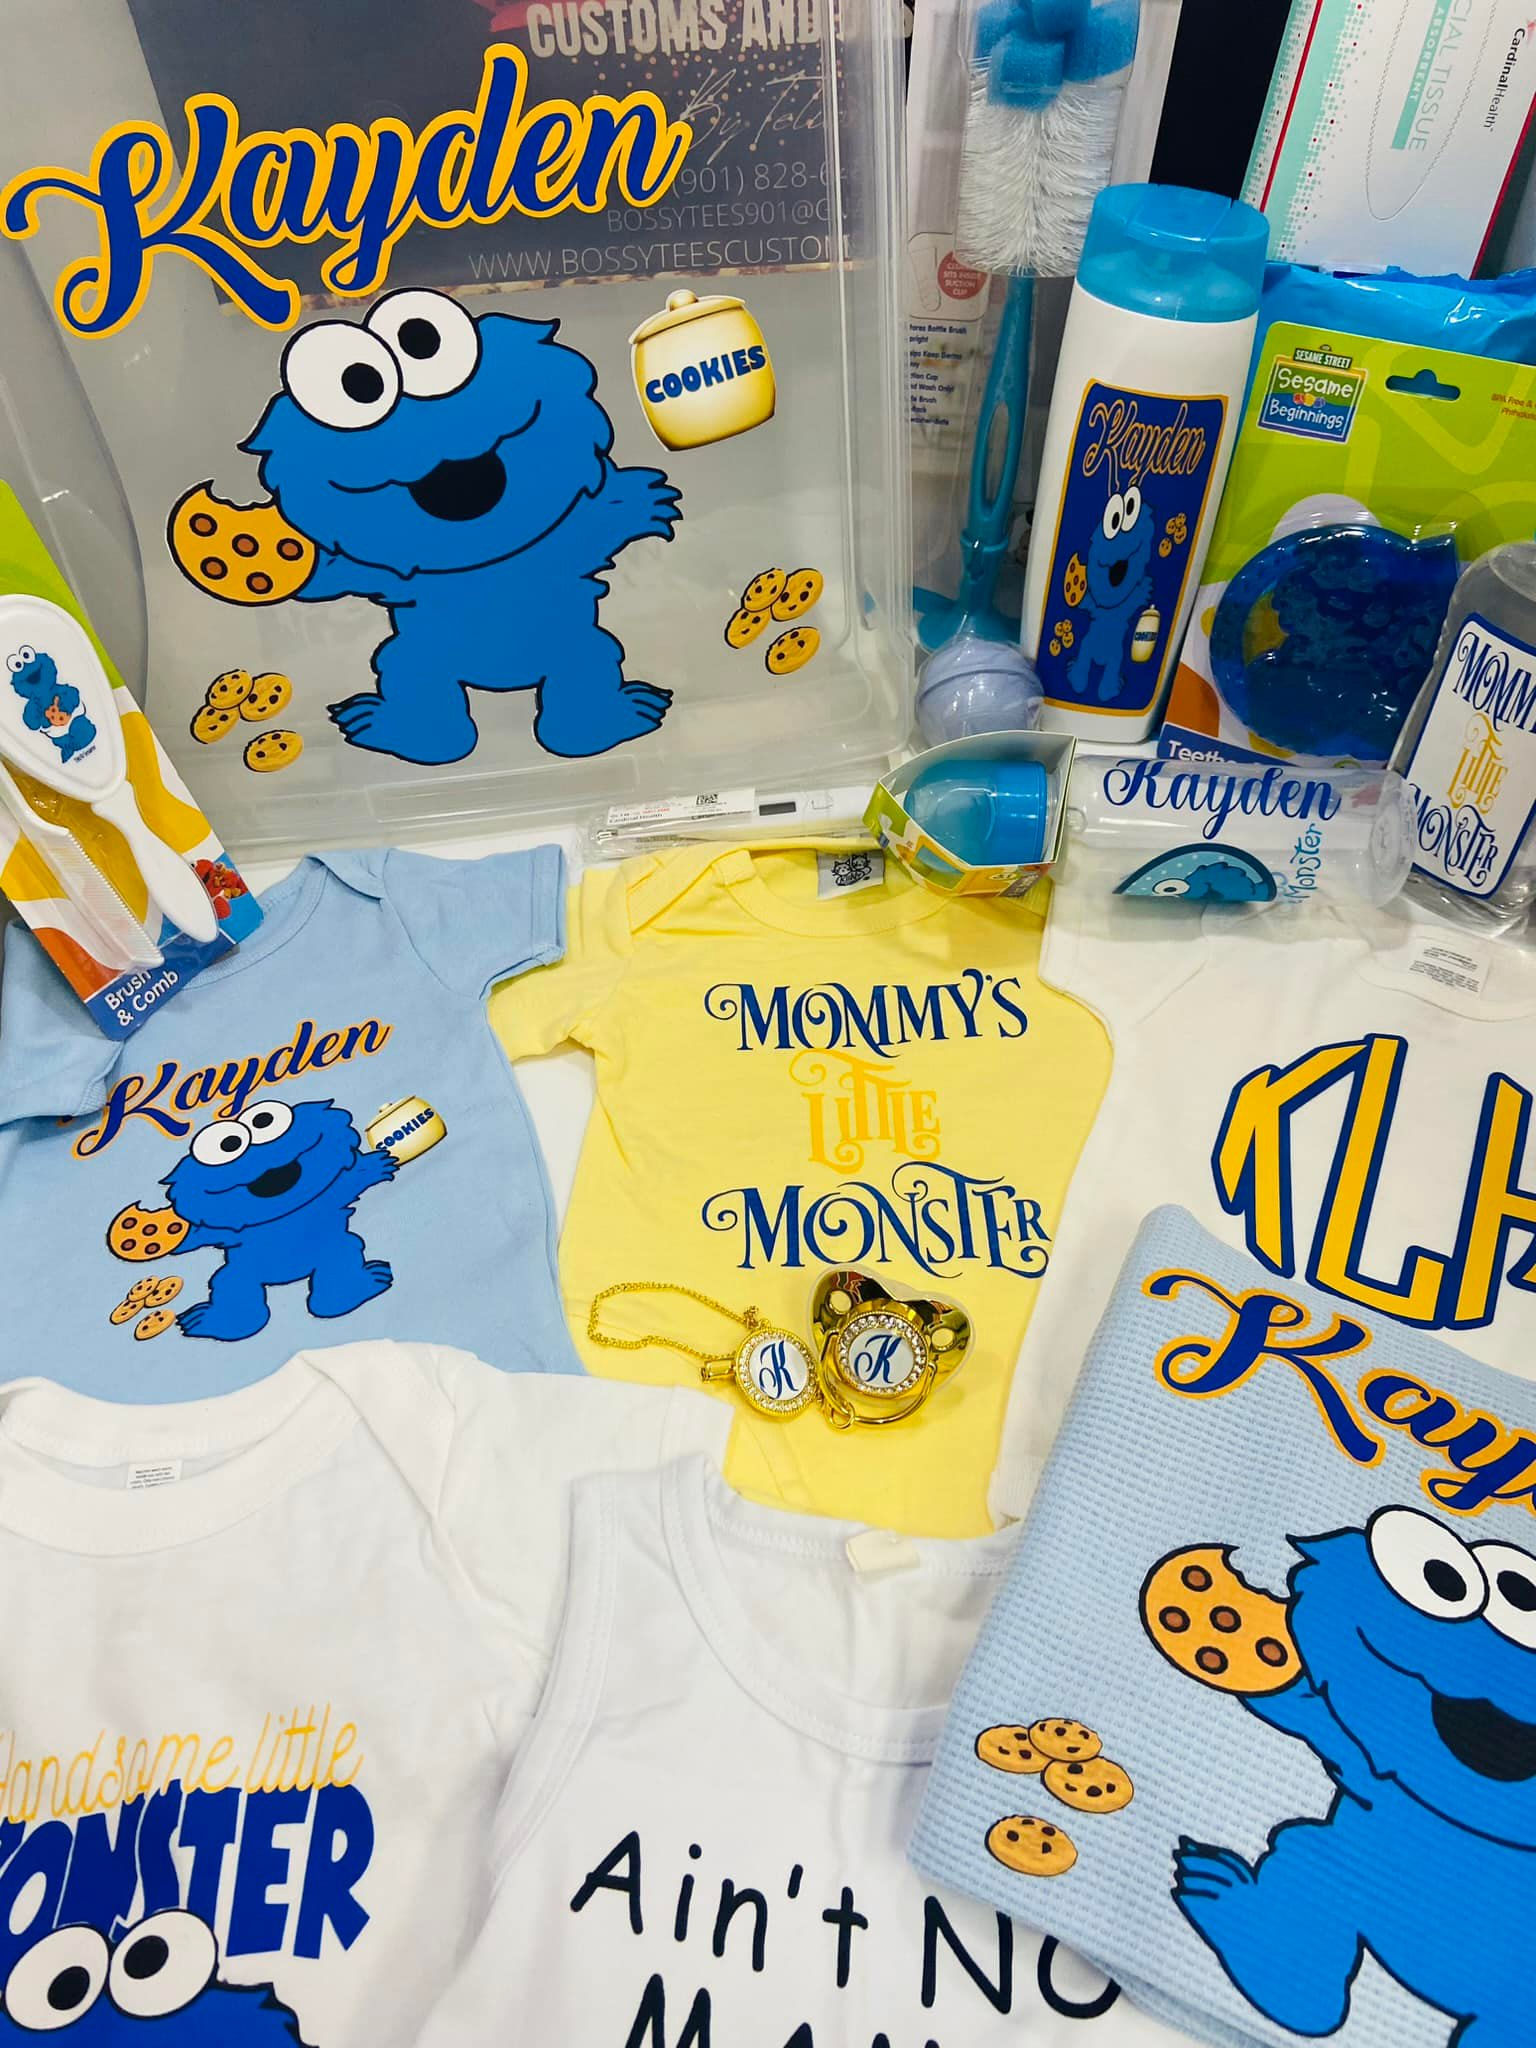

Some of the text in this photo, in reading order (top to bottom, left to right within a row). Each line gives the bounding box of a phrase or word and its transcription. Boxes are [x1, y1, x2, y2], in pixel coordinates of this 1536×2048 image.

[526, 0, 728, 58] CUSTOMS
[1408, 65, 1452, 151] TISSUE
[0, 43, 693, 340] Kayden
[607, 199, 847, 233] BOSSYTEES901@G
[645, 345, 766, 404] COOKIES
[1278, 368, 1353, 398] Sesame
[1295, 349, 1352, 369] SESAME STREET
[1082, 399, 1206, 497] Kayden
[1269, 398, 1345, 430] Beginnings
[1452, 631, 1536, 734] MOMM
[1103, 759, 1342, 840] Kayden
[1447, 712, 1509, 814] LITTLE
[1284, 822, 1323, 903] Monster
[104, 970, 152, 1010] Brush
[117, 970, 179, 1027] & Comb
[704, 968, 1028, 1058] MOMMY'S
[71, 1016, 396, 1160] Kayden
[375, 1107, 434, 1150] COOKIES
[788, 1047, 941, 1175] LITTLE
[701, 1161, 1052, 1279] MONSTER
[758, 1340, 798, 1400] K
[853, 1334, 902, 1384] K
[1141, 1266, 1536, 1517] Kay
[244, 1702, 365, 1794] little
[0, 1778, 376, 1960] ONSTER
[570, 1830, 869, 1988] Ain't
